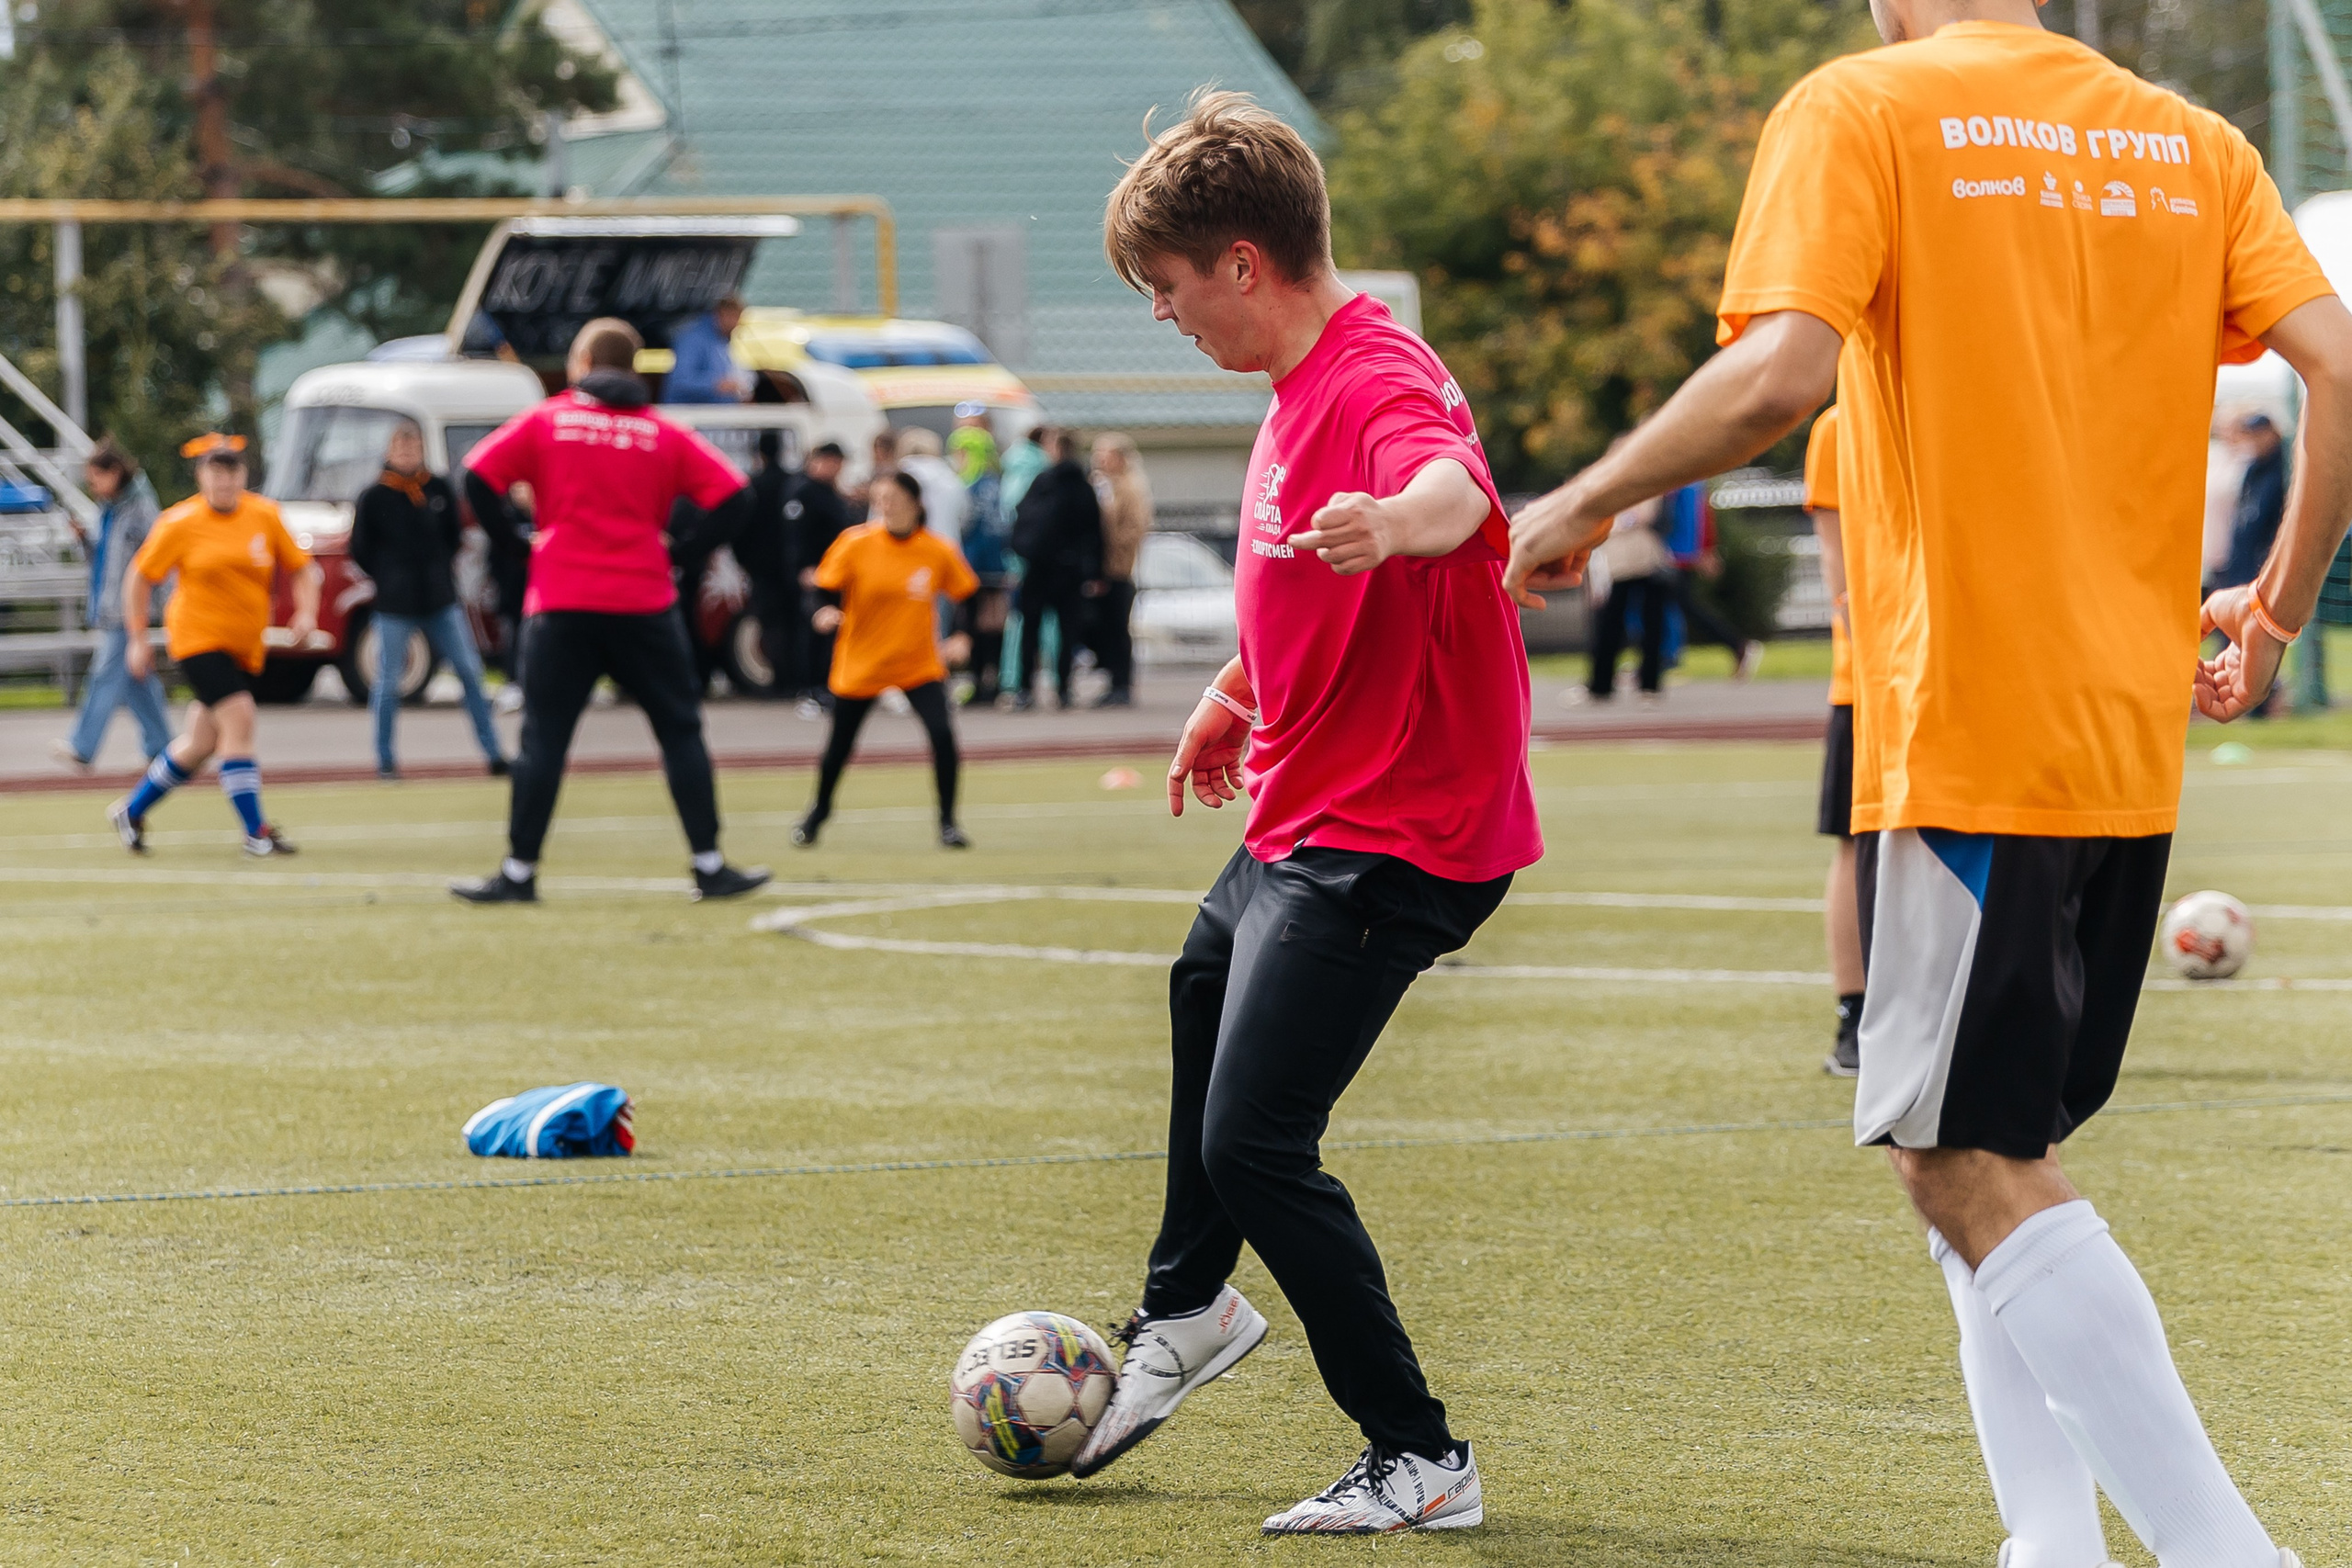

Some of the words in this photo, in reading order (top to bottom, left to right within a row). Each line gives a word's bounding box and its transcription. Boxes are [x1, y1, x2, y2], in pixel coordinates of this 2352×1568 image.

[1939, 116, 2077, 156] ВОЛКОВ
[2086, 129, 2190, 165] ГРУПП
[1253, 501, 1282, 525] СПАРТА
[1250, 538, 1295, 558] СПОРТСМЕН
